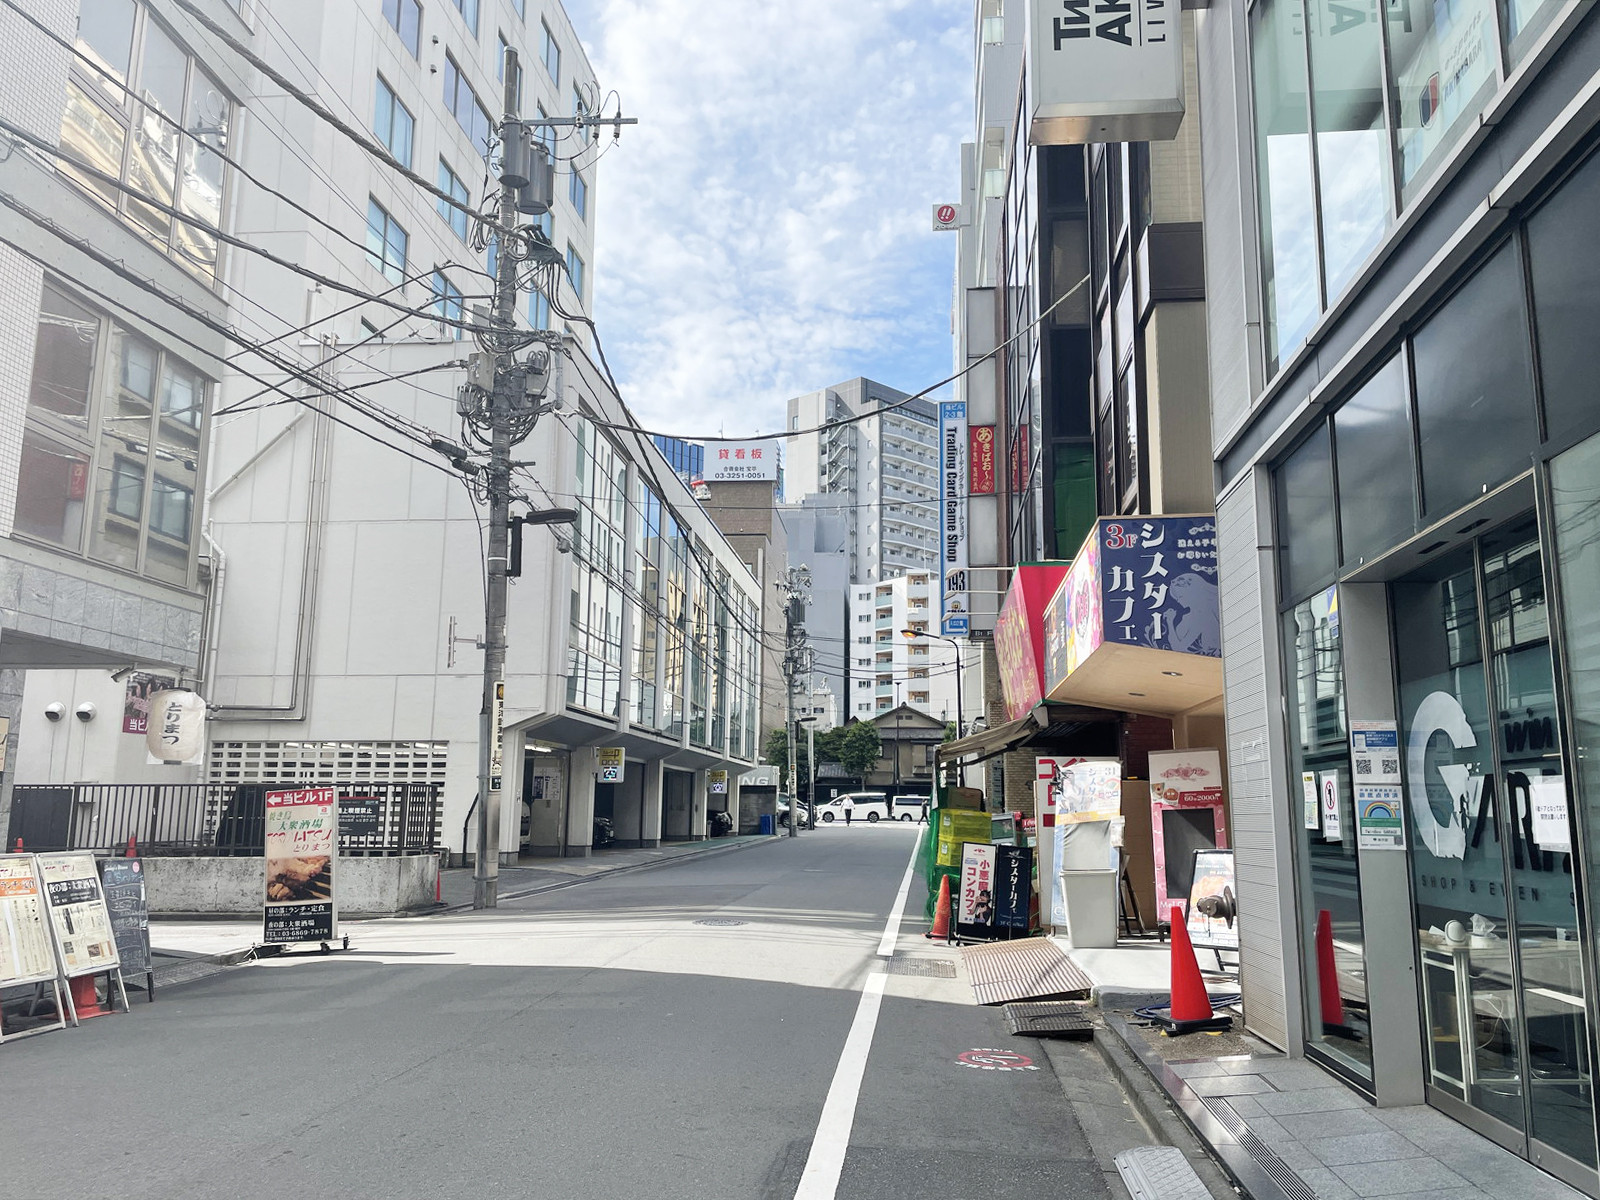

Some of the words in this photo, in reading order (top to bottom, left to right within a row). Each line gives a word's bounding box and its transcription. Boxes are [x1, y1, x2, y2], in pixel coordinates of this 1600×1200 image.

[718, 448, 762, 460] 貸看板
[946, 427, 957, 469] Trading
[946, 472, 957, 498] Card
[946, 500, 957, 531] Game
[946, 535, 958, 562] Shop
[1106, 523, 1138, 549] 3F
[1140, 522, 1169, 641] シスター
[1107, 565, 1138, 641] カフェ
[162, 701, 182, 745] とりまつ
[283, 790, 333, 805] 当ビル1F
[293, 843, 331, 853] とりまつ
[965, 866, 977, 916] コンカフェ
[1421, 874, 1457, 891] SHOP
[1469, 879, 1476, 893] &
[282, 928, 329, 937] 03-6869-7878
